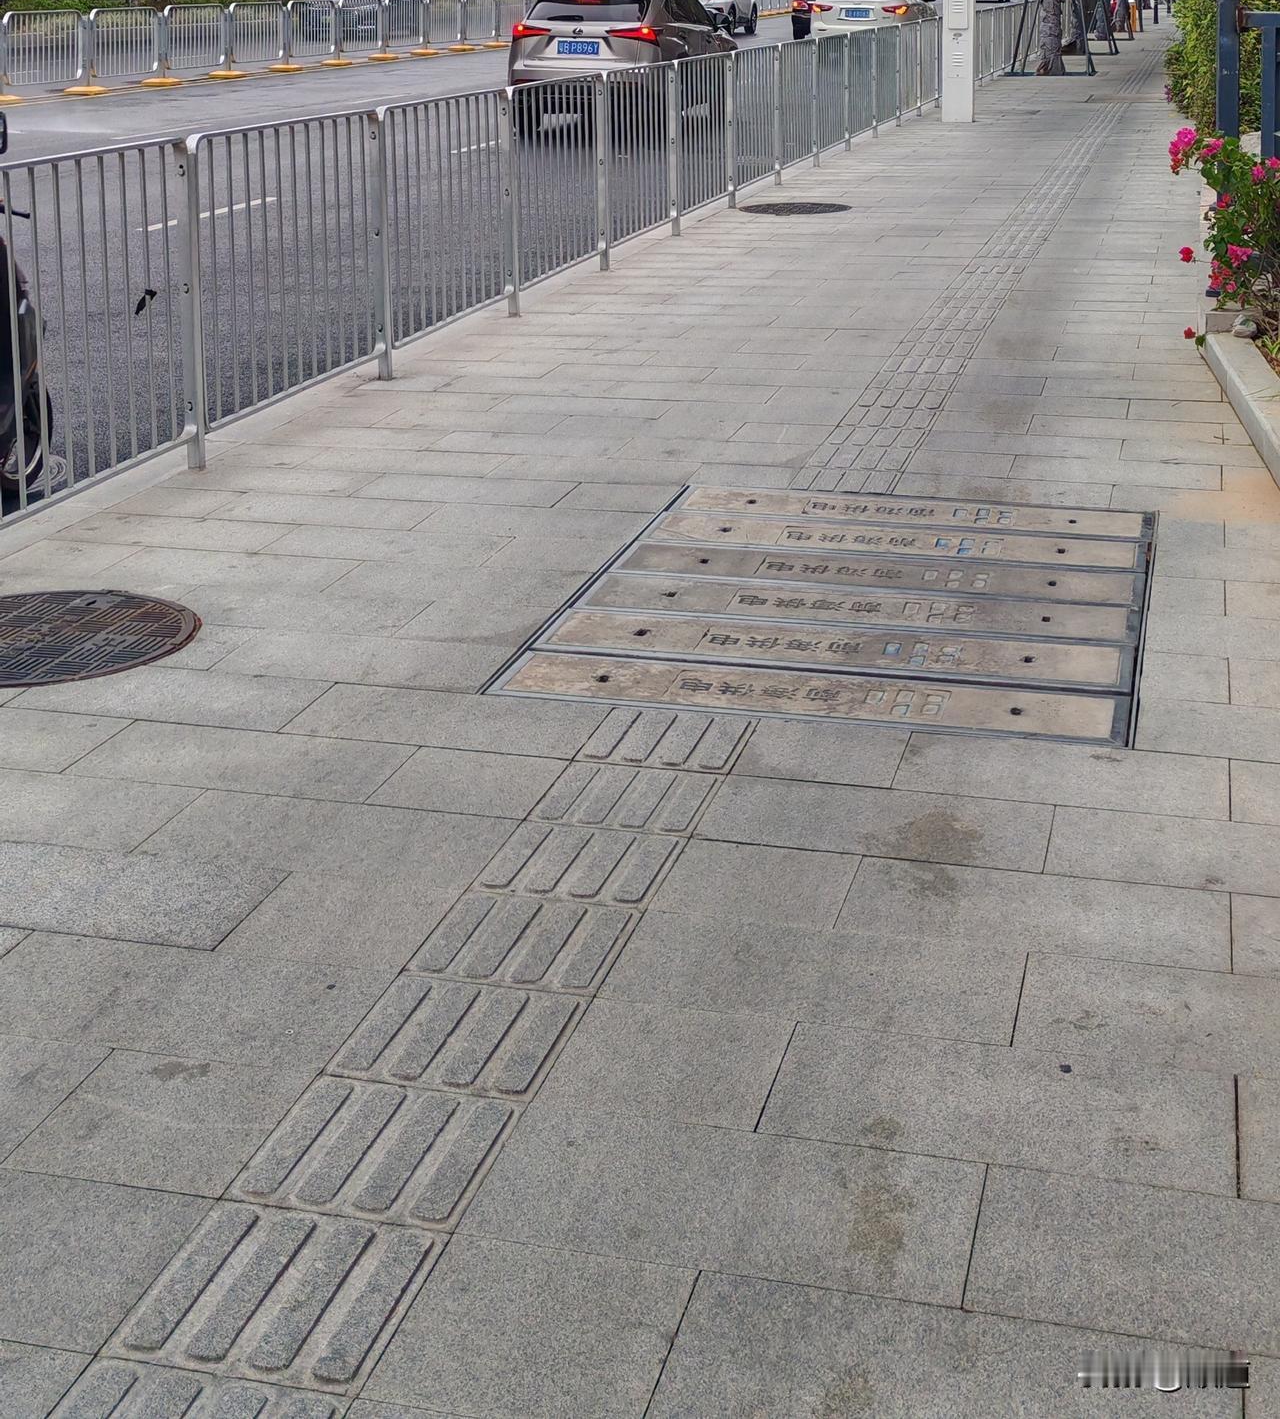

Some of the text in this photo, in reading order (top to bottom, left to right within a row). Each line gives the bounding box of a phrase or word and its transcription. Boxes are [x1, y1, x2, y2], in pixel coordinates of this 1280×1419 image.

[767, 561, 903, 580] 前海供电
[738, 594, 882, 614] 前海供电
[709, 634, 864, 655] 前海供电
[681, 678, 840, 702] 前海供电
